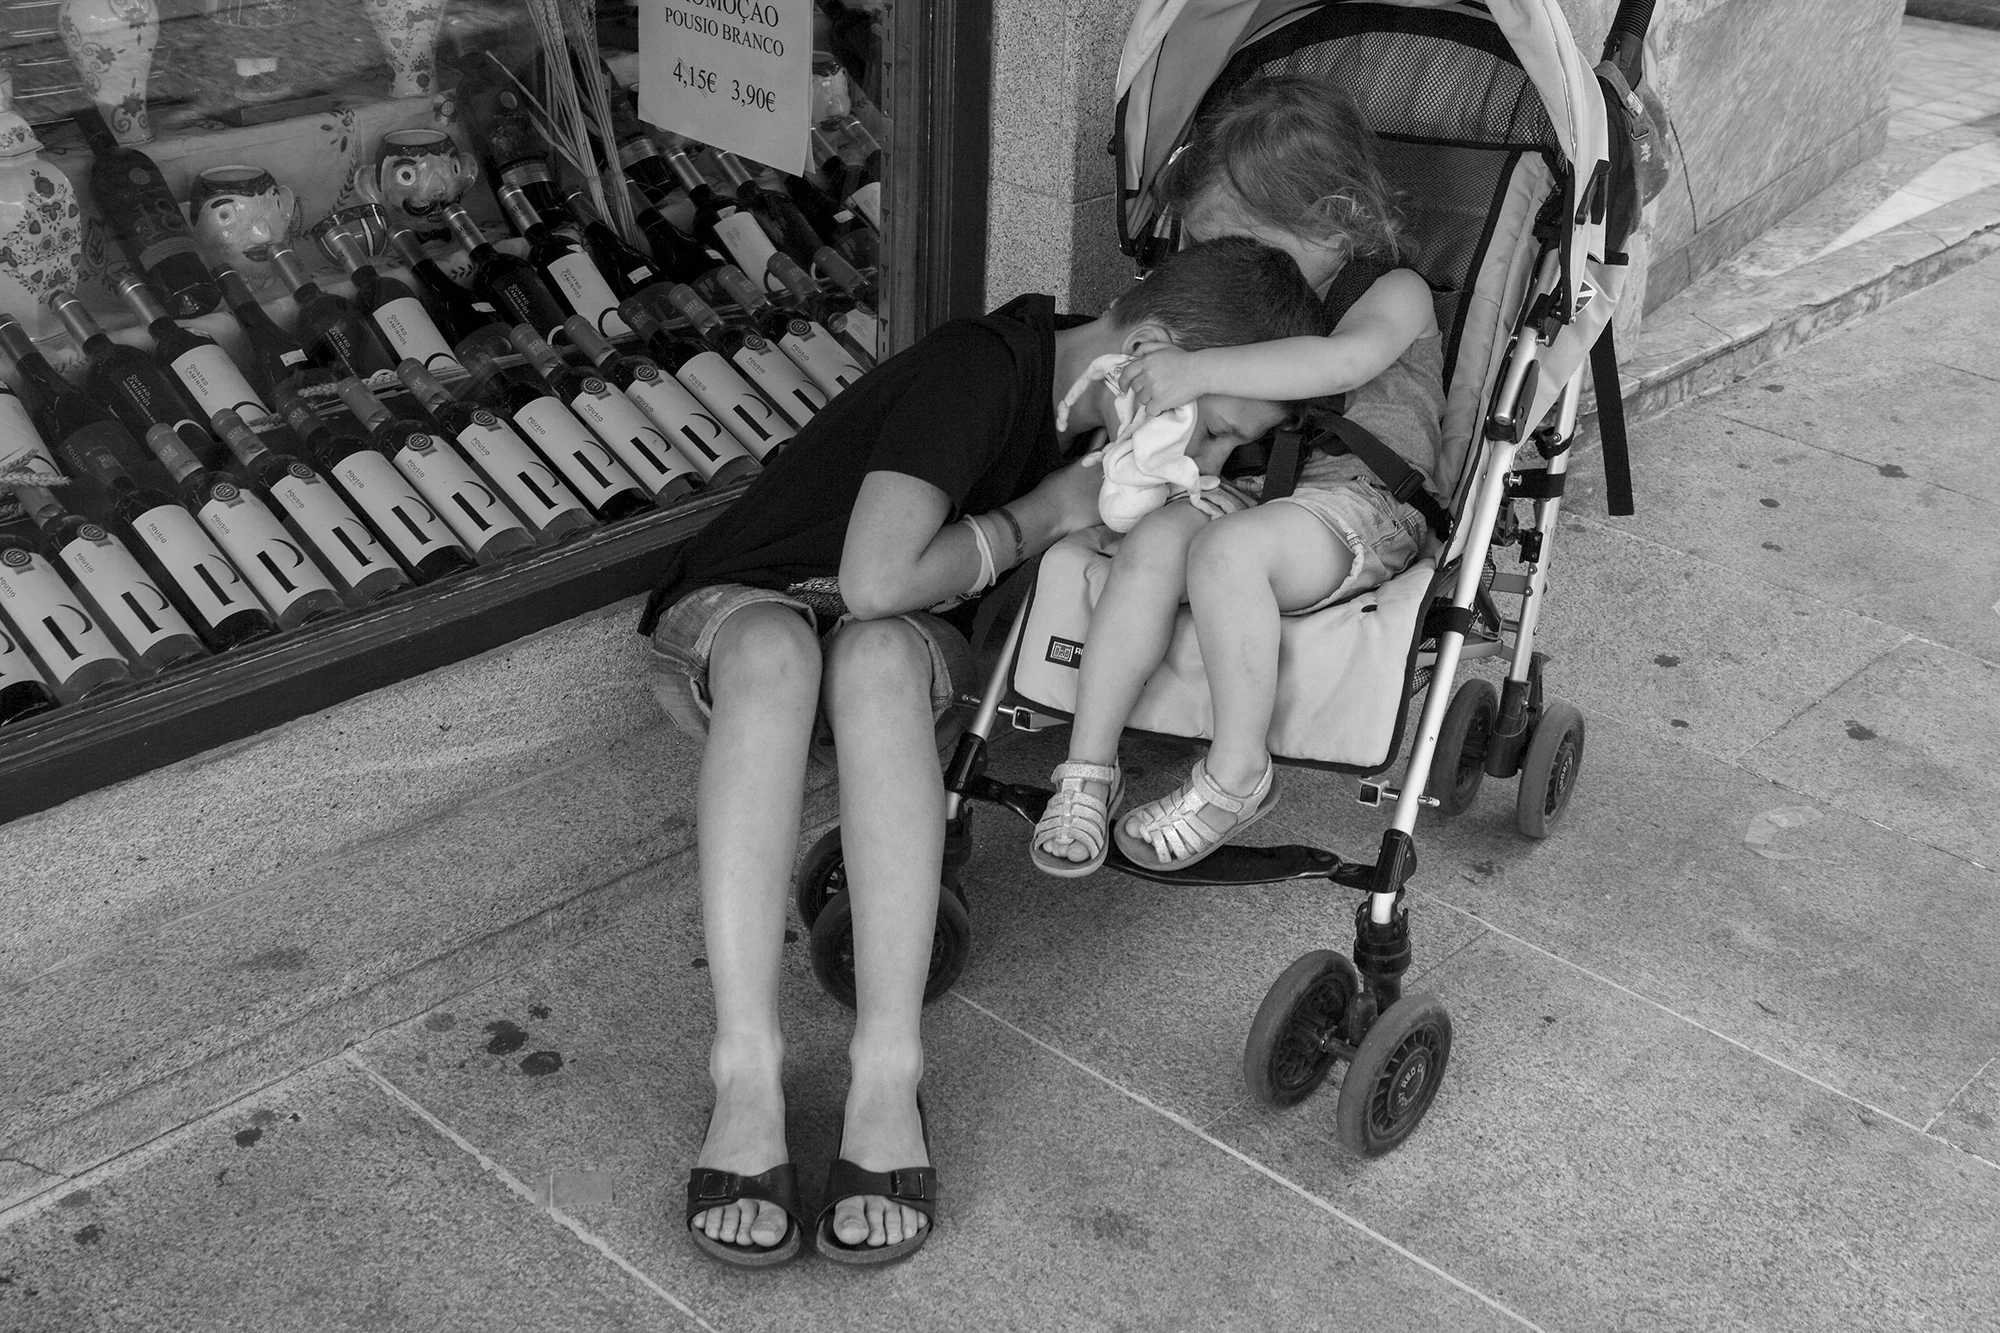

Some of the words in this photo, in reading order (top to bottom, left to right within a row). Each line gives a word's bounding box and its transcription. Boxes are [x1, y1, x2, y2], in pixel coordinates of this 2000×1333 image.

[665, 7, 718, 37] POUSIO
[722, 23, 784, 57] BRANCO
[672, 61, 718, 93] 4,15€
[731, 79, 776, 112] 3,90€
[792, 343, 809, 361] POUSIO
[748, 356, 765, 374] POUSIO
[185, 367, 208, 396] CAMINHOS
[190, 364, 208, 386] QUATRO
[689, 373, 707, 392] POUSIO
[586, 403, 604, 422] POUSIO
[637, 395, 654, 413] POUSIO
[528, 416, 546, 435] POUSIO
[472, 437, 490, 456] POUSIO
[408, 459, 425, 478] POUSIO
[347, 470, 365, 489] POUSIO
[287, 489, 305, 509] POUSIO
[149, 523, 167, 544] POUSIO
[213, 514, 230, 535] POUSIO
[76, 552, 94, 573] POUSIO
